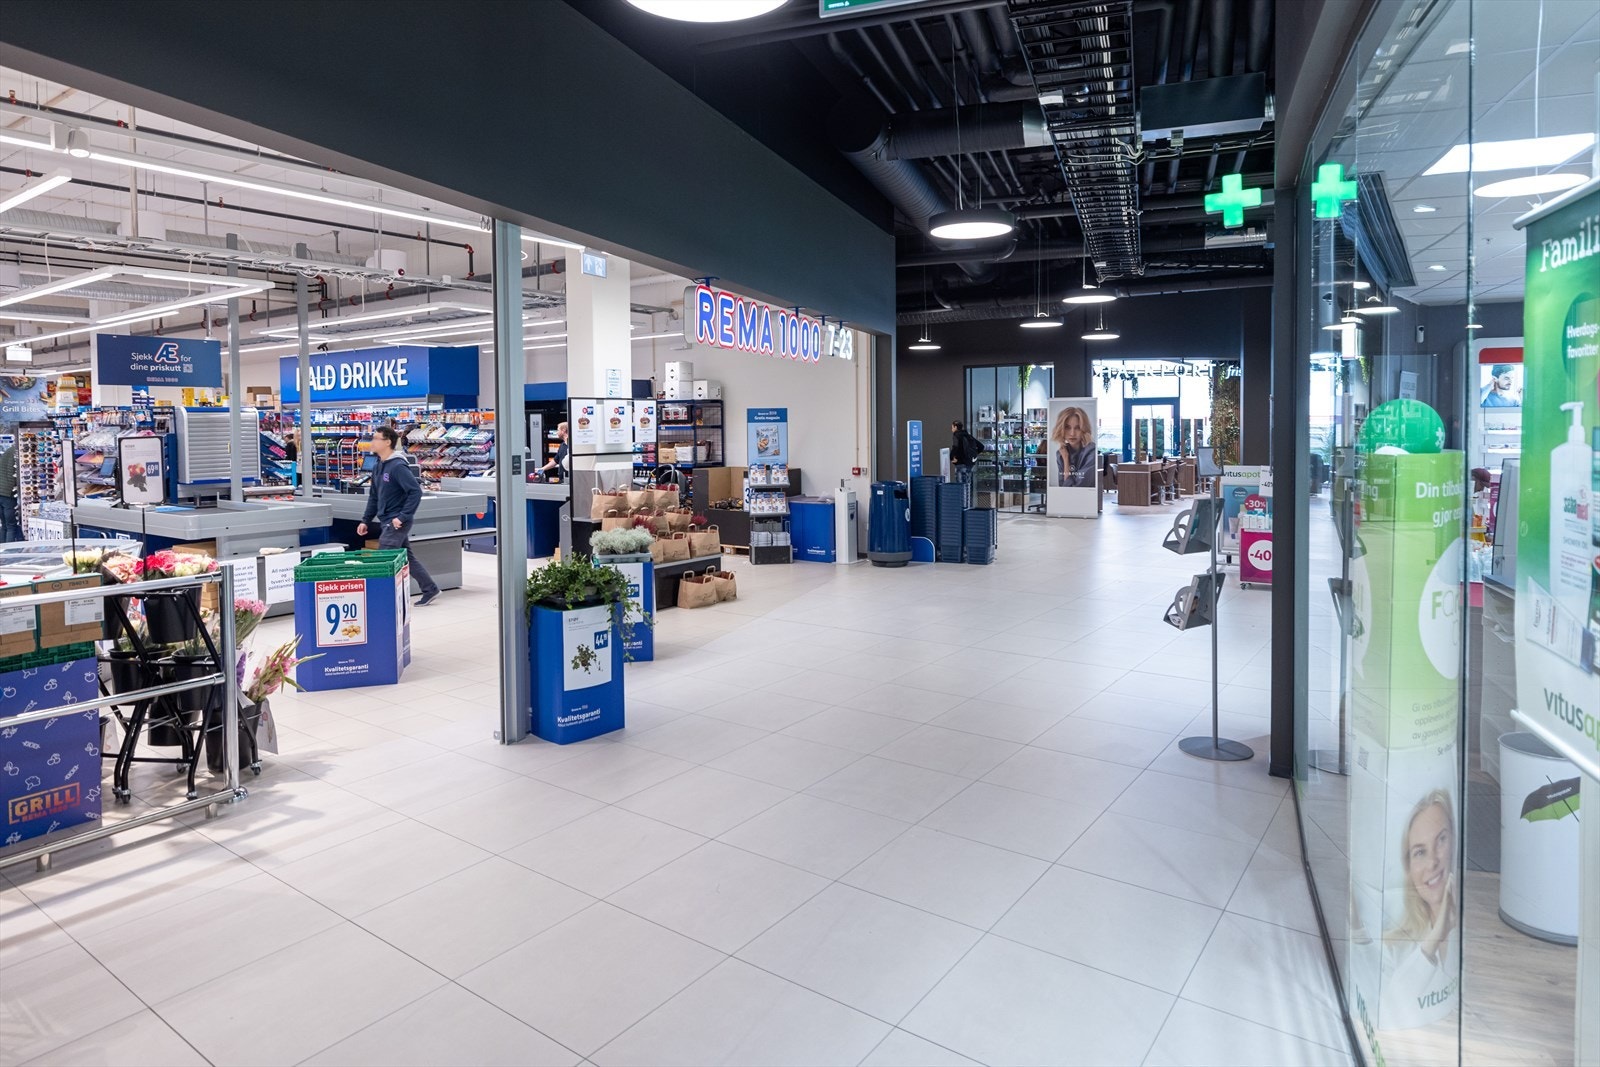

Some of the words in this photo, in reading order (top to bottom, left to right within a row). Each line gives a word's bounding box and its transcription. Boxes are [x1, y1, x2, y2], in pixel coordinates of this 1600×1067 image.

[696, 284, 774, 356] REMA
[778, 309, 821, 364] 1000
[828, 324, 853, 361] 7-23
[131, 352, 153, 362] Sjekk
[154, 342, 180, 364] Æ
[180, 354, 192, 362] for
[1566, 344, 1600, 359] favoritter
[130, 363, 149, 371] dine
[150, 363, 182, 372] priskutt
[340, 357, 409, 390] DRIKKE
[2, 405, 20, 413] Grill
[1415, 482, 1440, 499] Din
[1245, 499, 1266, 508] -30%
[1433, 507, 1452, 528] gjør
[317, 583, 339, 592] Sjekk
[340, 583, 364, 592] prisen
[326, 603, 341, 636] 9
[342, 603, 358, 619] 90
[324, 663, 369, 673] Kvalitetsgaranti
[557, 708, 601, 723] Kvalitetsgaranti
[14, 789, 75, 817] GRILL
